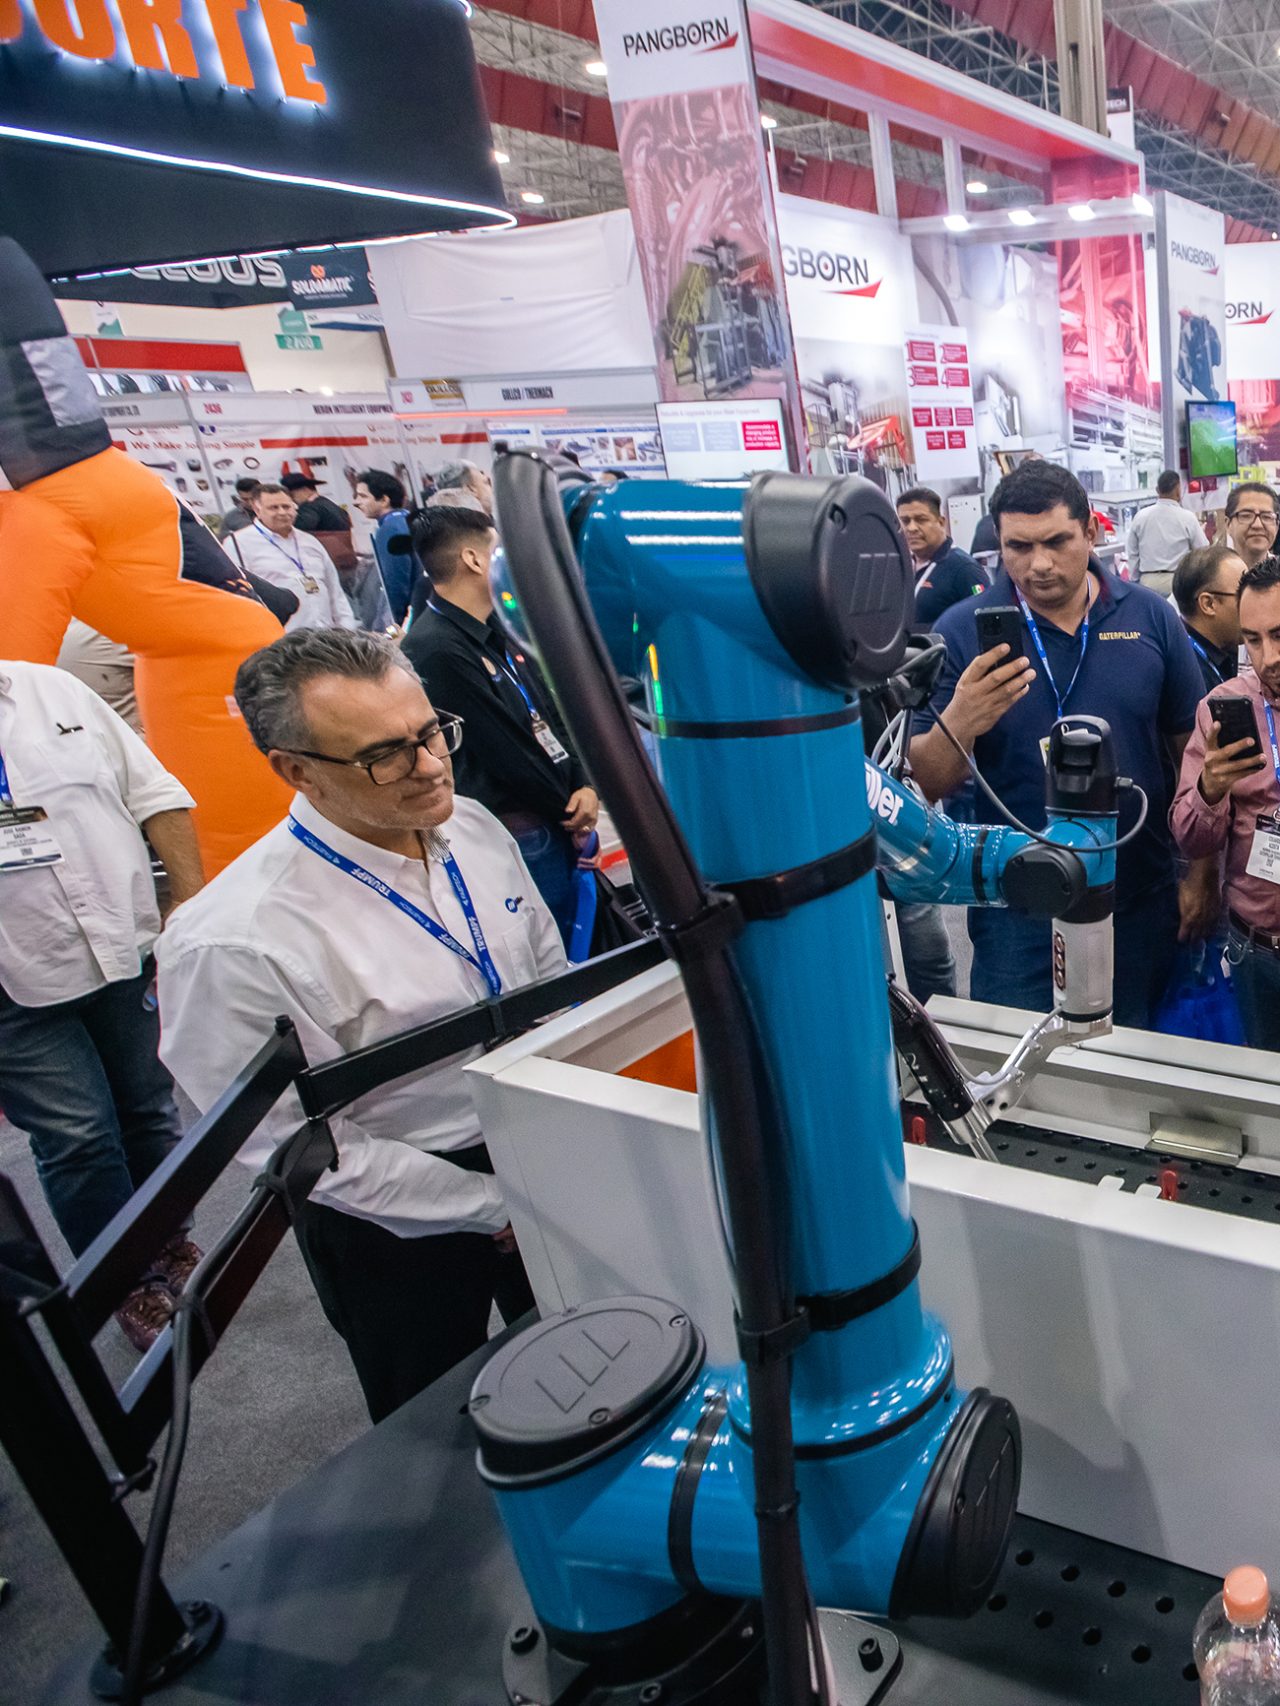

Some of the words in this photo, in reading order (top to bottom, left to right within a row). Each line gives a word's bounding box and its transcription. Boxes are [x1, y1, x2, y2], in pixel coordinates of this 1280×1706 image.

[623, 16, 730, 57] PANGBORN
[1171, 241, 1216, 267] PANGBORN
[1099, 632, 1138, 641] CATERPILLAR
[351, 867, 391, 897] TRUMPF
[468, 916, 486, 952] TRUMPF
